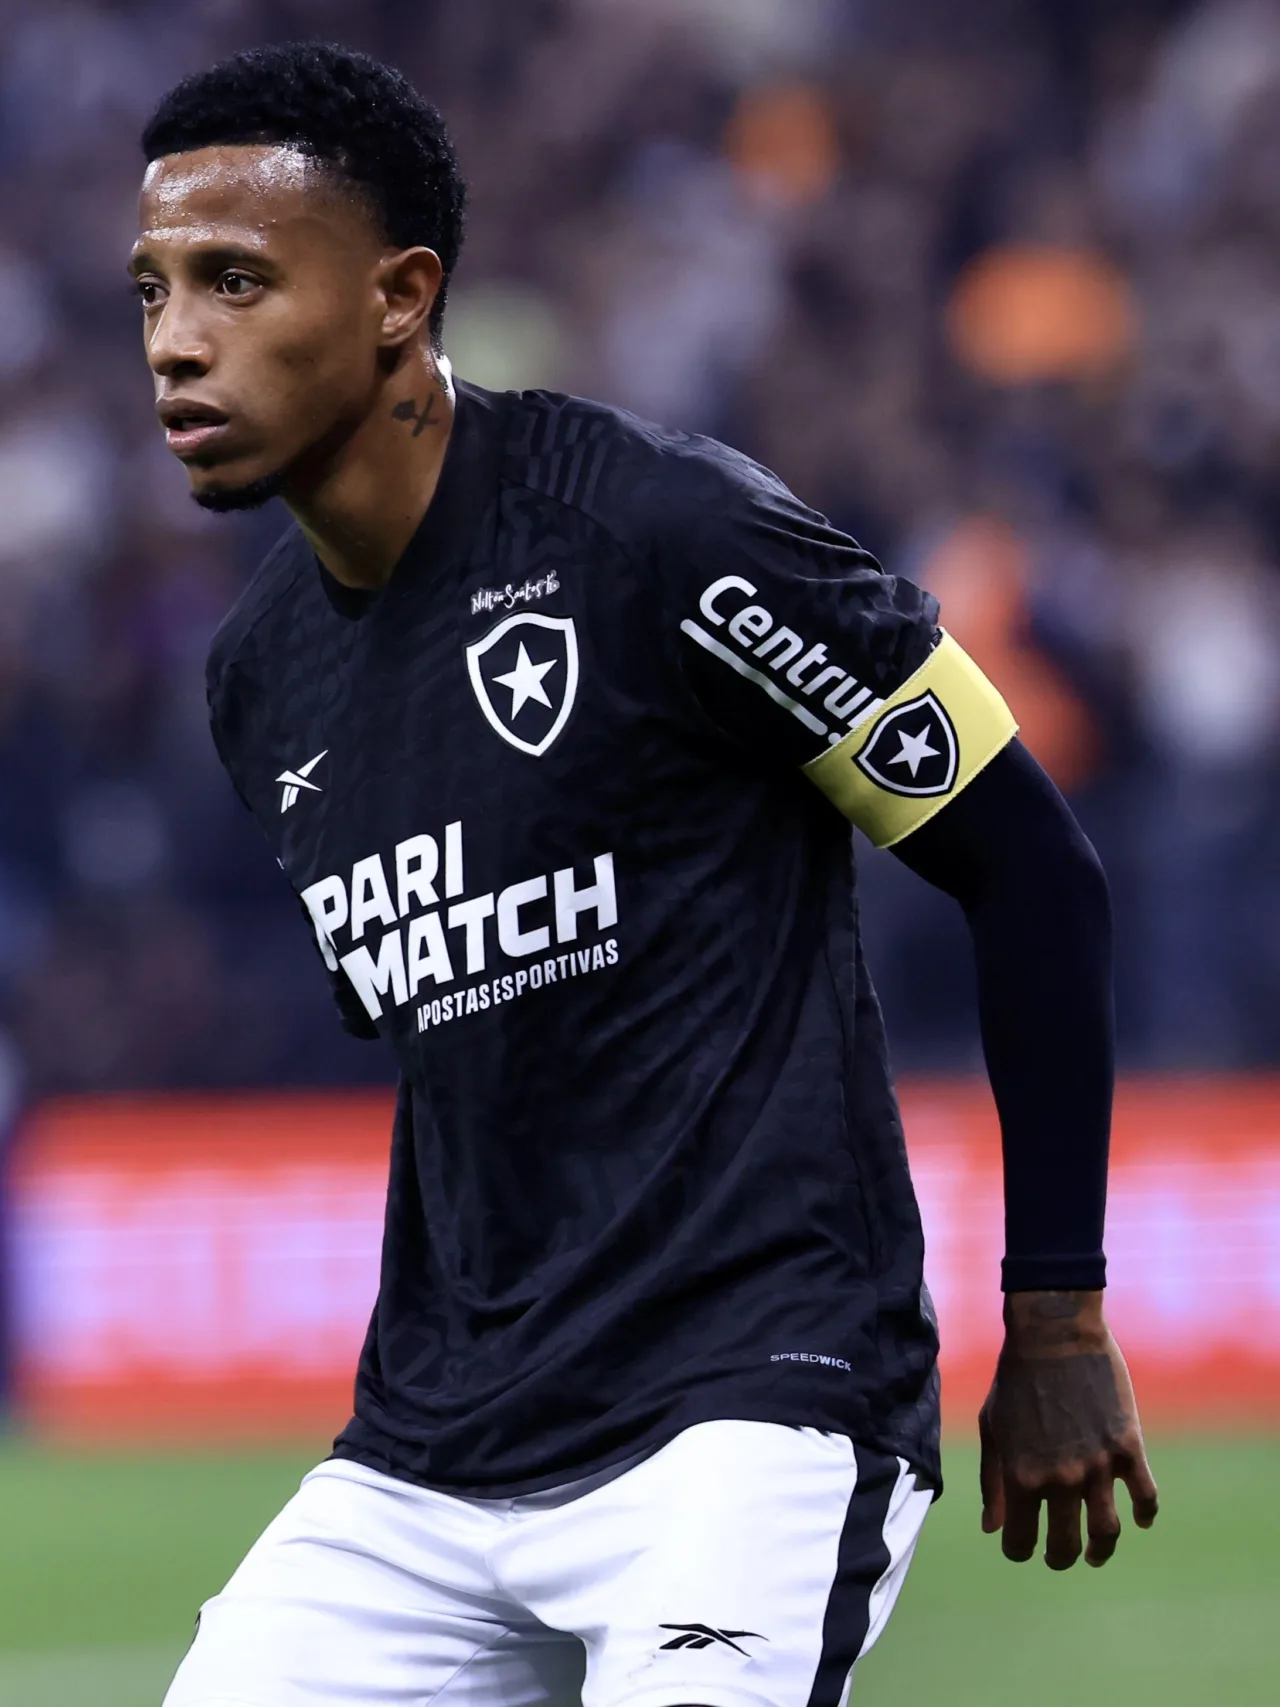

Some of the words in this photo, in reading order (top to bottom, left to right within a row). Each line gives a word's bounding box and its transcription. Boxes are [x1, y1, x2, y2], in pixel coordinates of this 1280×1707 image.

[503, 579, 543, 609] Santos
[301, 820, 464, 972] PARI
[339, 851, 619, 1022] MATCH
[770, 1352, 852, 1372] SPEEDWICK
